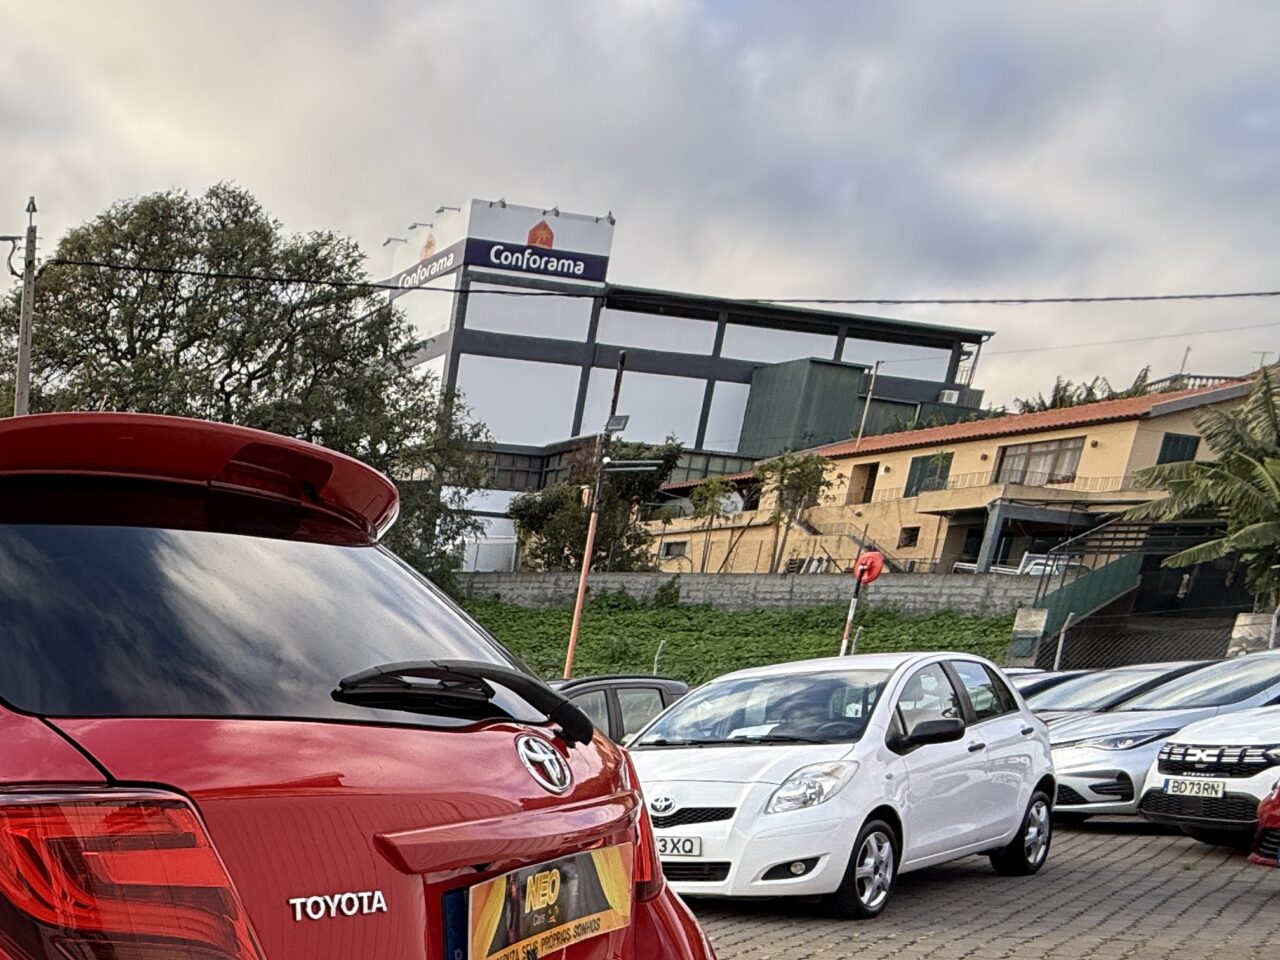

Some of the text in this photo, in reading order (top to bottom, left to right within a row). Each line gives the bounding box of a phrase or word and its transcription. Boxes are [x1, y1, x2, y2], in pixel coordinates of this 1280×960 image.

[397, 251, 455, 289] Conforama
[489, 245, 585, 276] Conforama
[289, 890, 388, 921] TOYOTA
[524, 868, 562, 914] NEO
[540, 927, 571, 952] PRÓPRIOS
[572, 917, 601, 940] SONHOS
